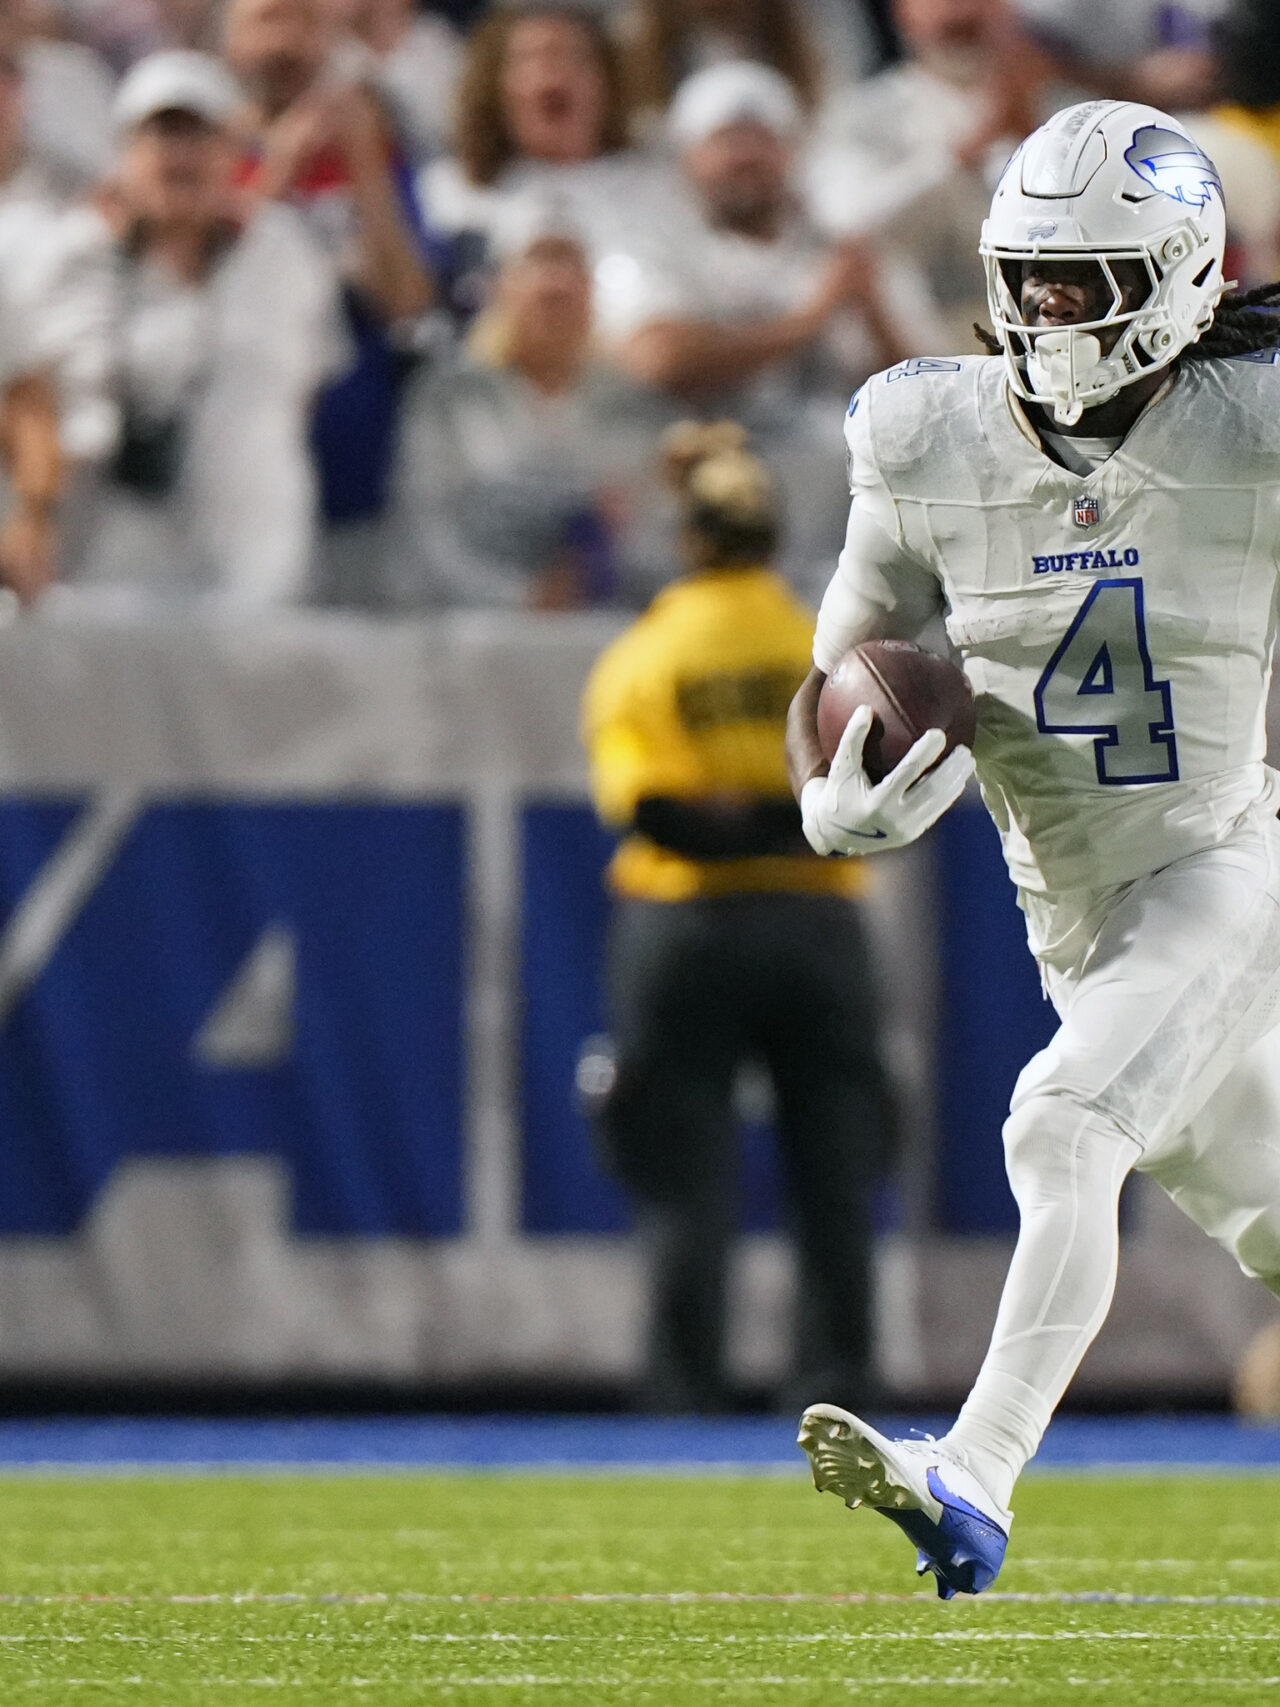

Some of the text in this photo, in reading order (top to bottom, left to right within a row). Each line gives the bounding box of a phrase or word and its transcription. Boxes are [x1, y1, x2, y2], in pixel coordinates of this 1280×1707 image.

[887, 358, 961, 383] 4
[1076, 509, 1097, 524] NFL
[1032, 548, 1139, 574] BUFFALO
[1033, 577, 1180, 785] 4
